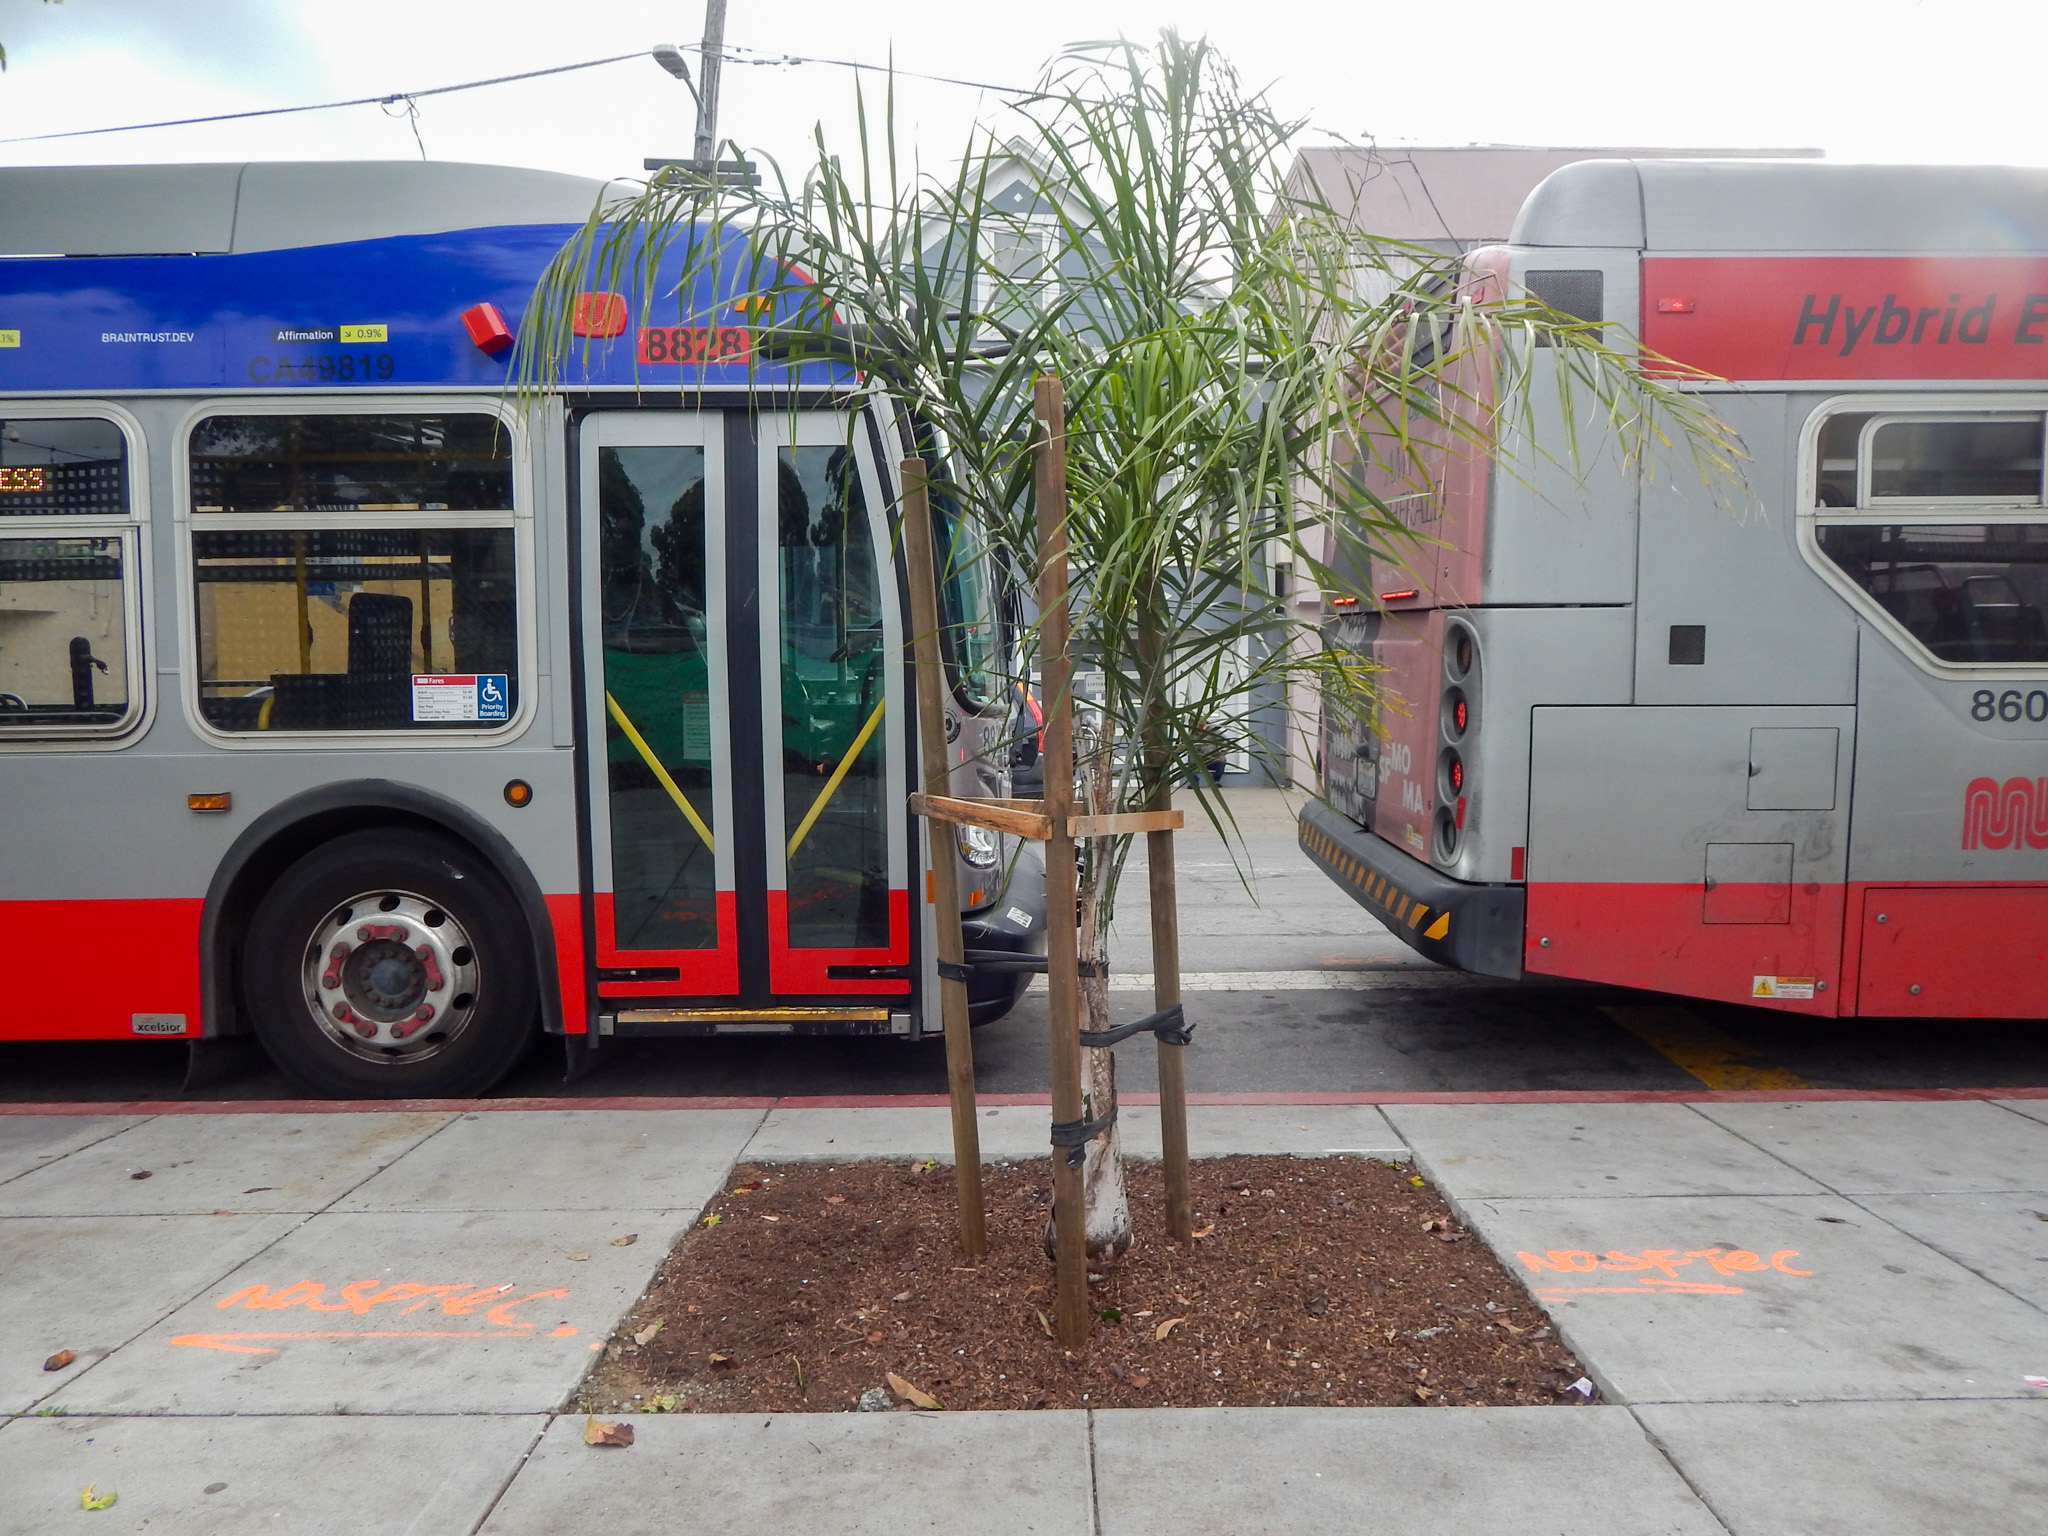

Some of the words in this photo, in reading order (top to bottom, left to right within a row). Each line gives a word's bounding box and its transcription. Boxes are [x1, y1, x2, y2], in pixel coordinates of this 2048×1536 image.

[101, 332, 195, 343] BRAINTRUST.DEV
[277, 330, 334, 341] Affirmation
[356, 328, 382, 338] 0.9%
[1792, 294, 1998, 356] Hybrid
[646, 328, 741, 361] 8828
[248, 353, 394, 383] CA49819
[0, 468, 44, 489] ESS
[481, 704, 504, 715] Priority
[1378, 754, 1392, 785] SF
[1391, 743, 1412, 775] MO
[1402, 779, 1425, 815] MA
[137, 1022, 182, 1032] xcelsior
